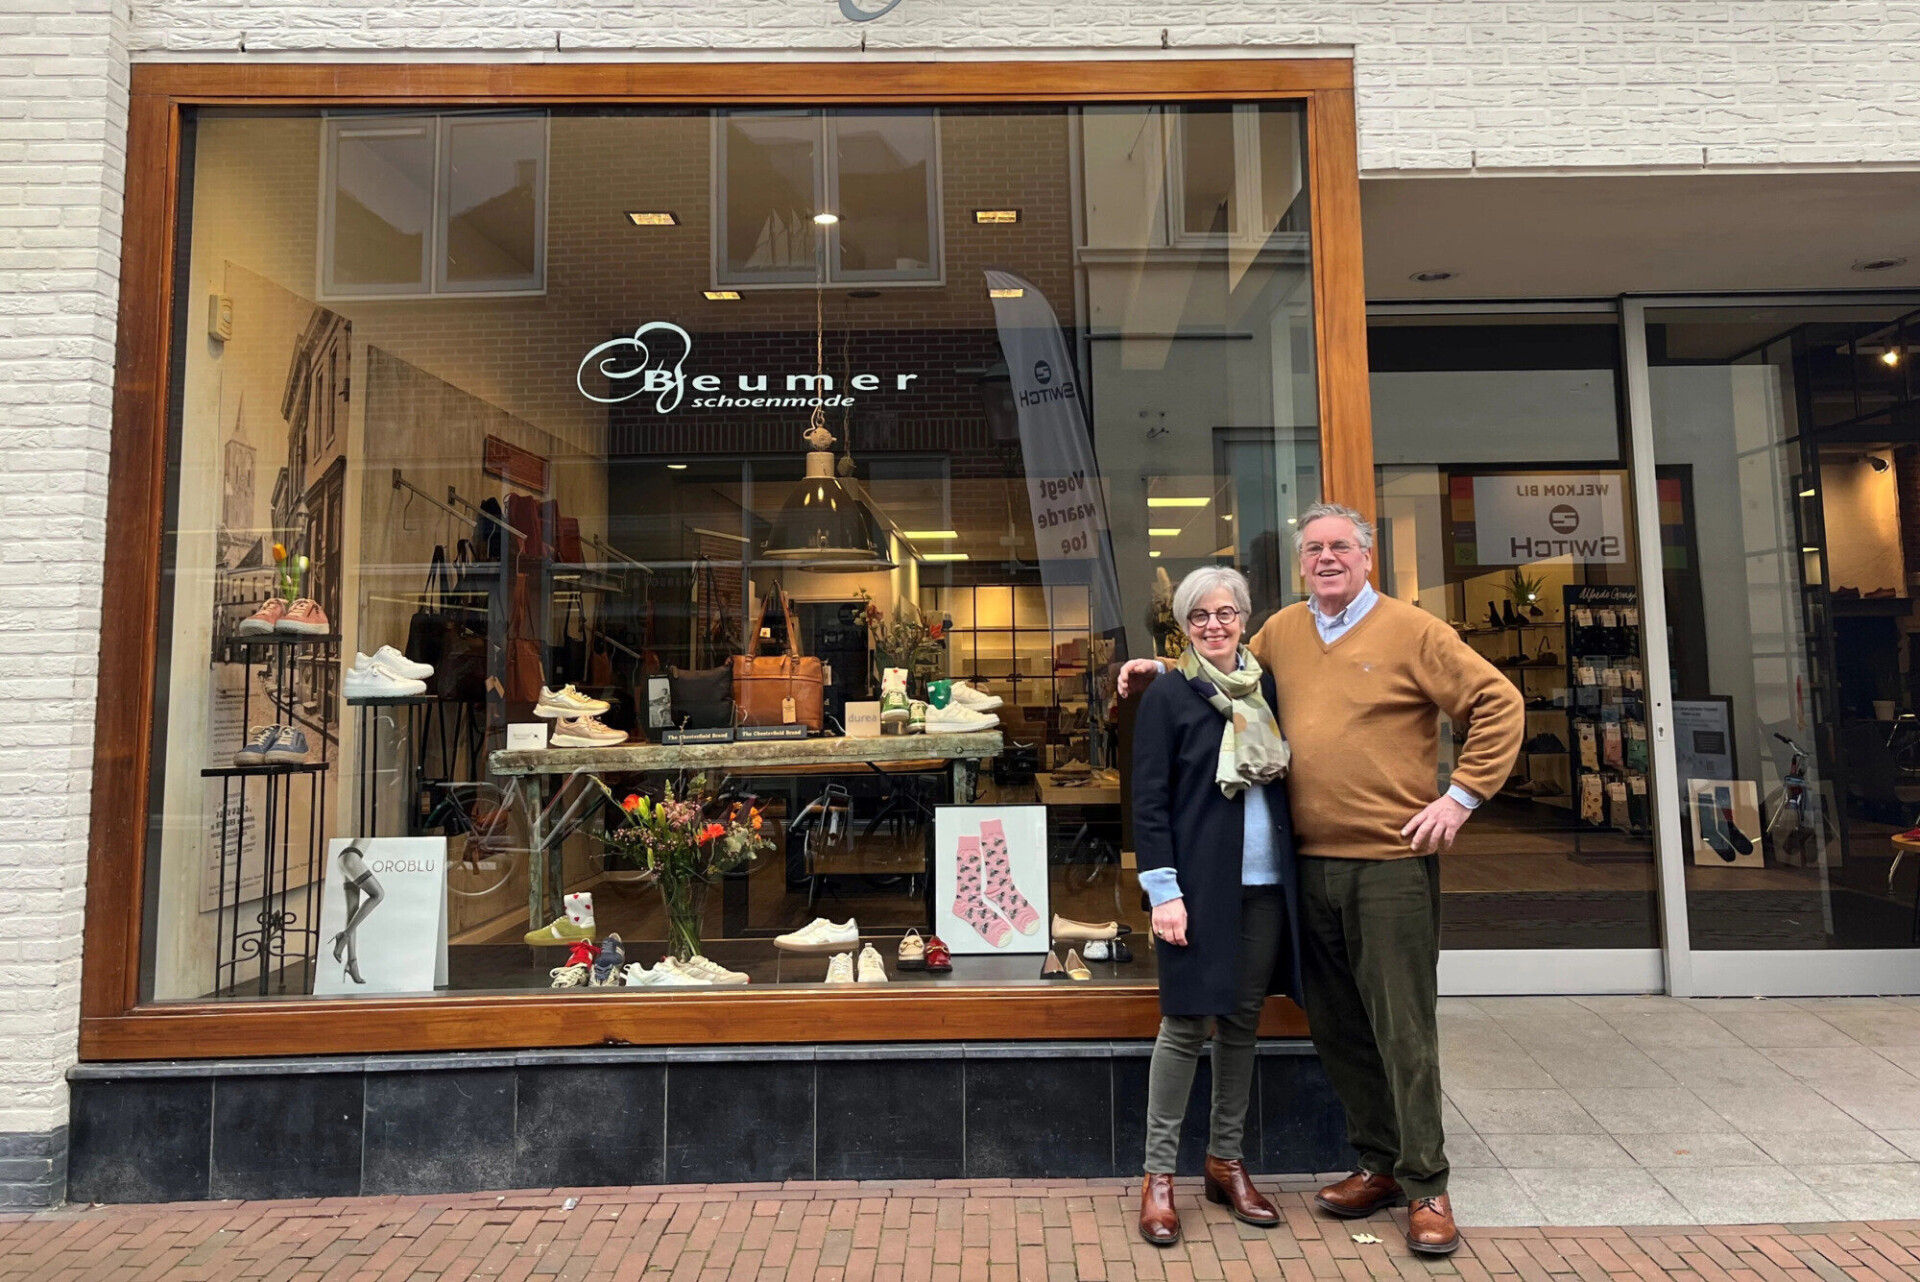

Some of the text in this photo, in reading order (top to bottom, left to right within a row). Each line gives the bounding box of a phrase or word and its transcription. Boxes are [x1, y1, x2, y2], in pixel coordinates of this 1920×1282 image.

[691, 394, 856, 408] schoenmode
[848, 712, 877, 723] durea
[372, 859, 435, 873] OROBLU
